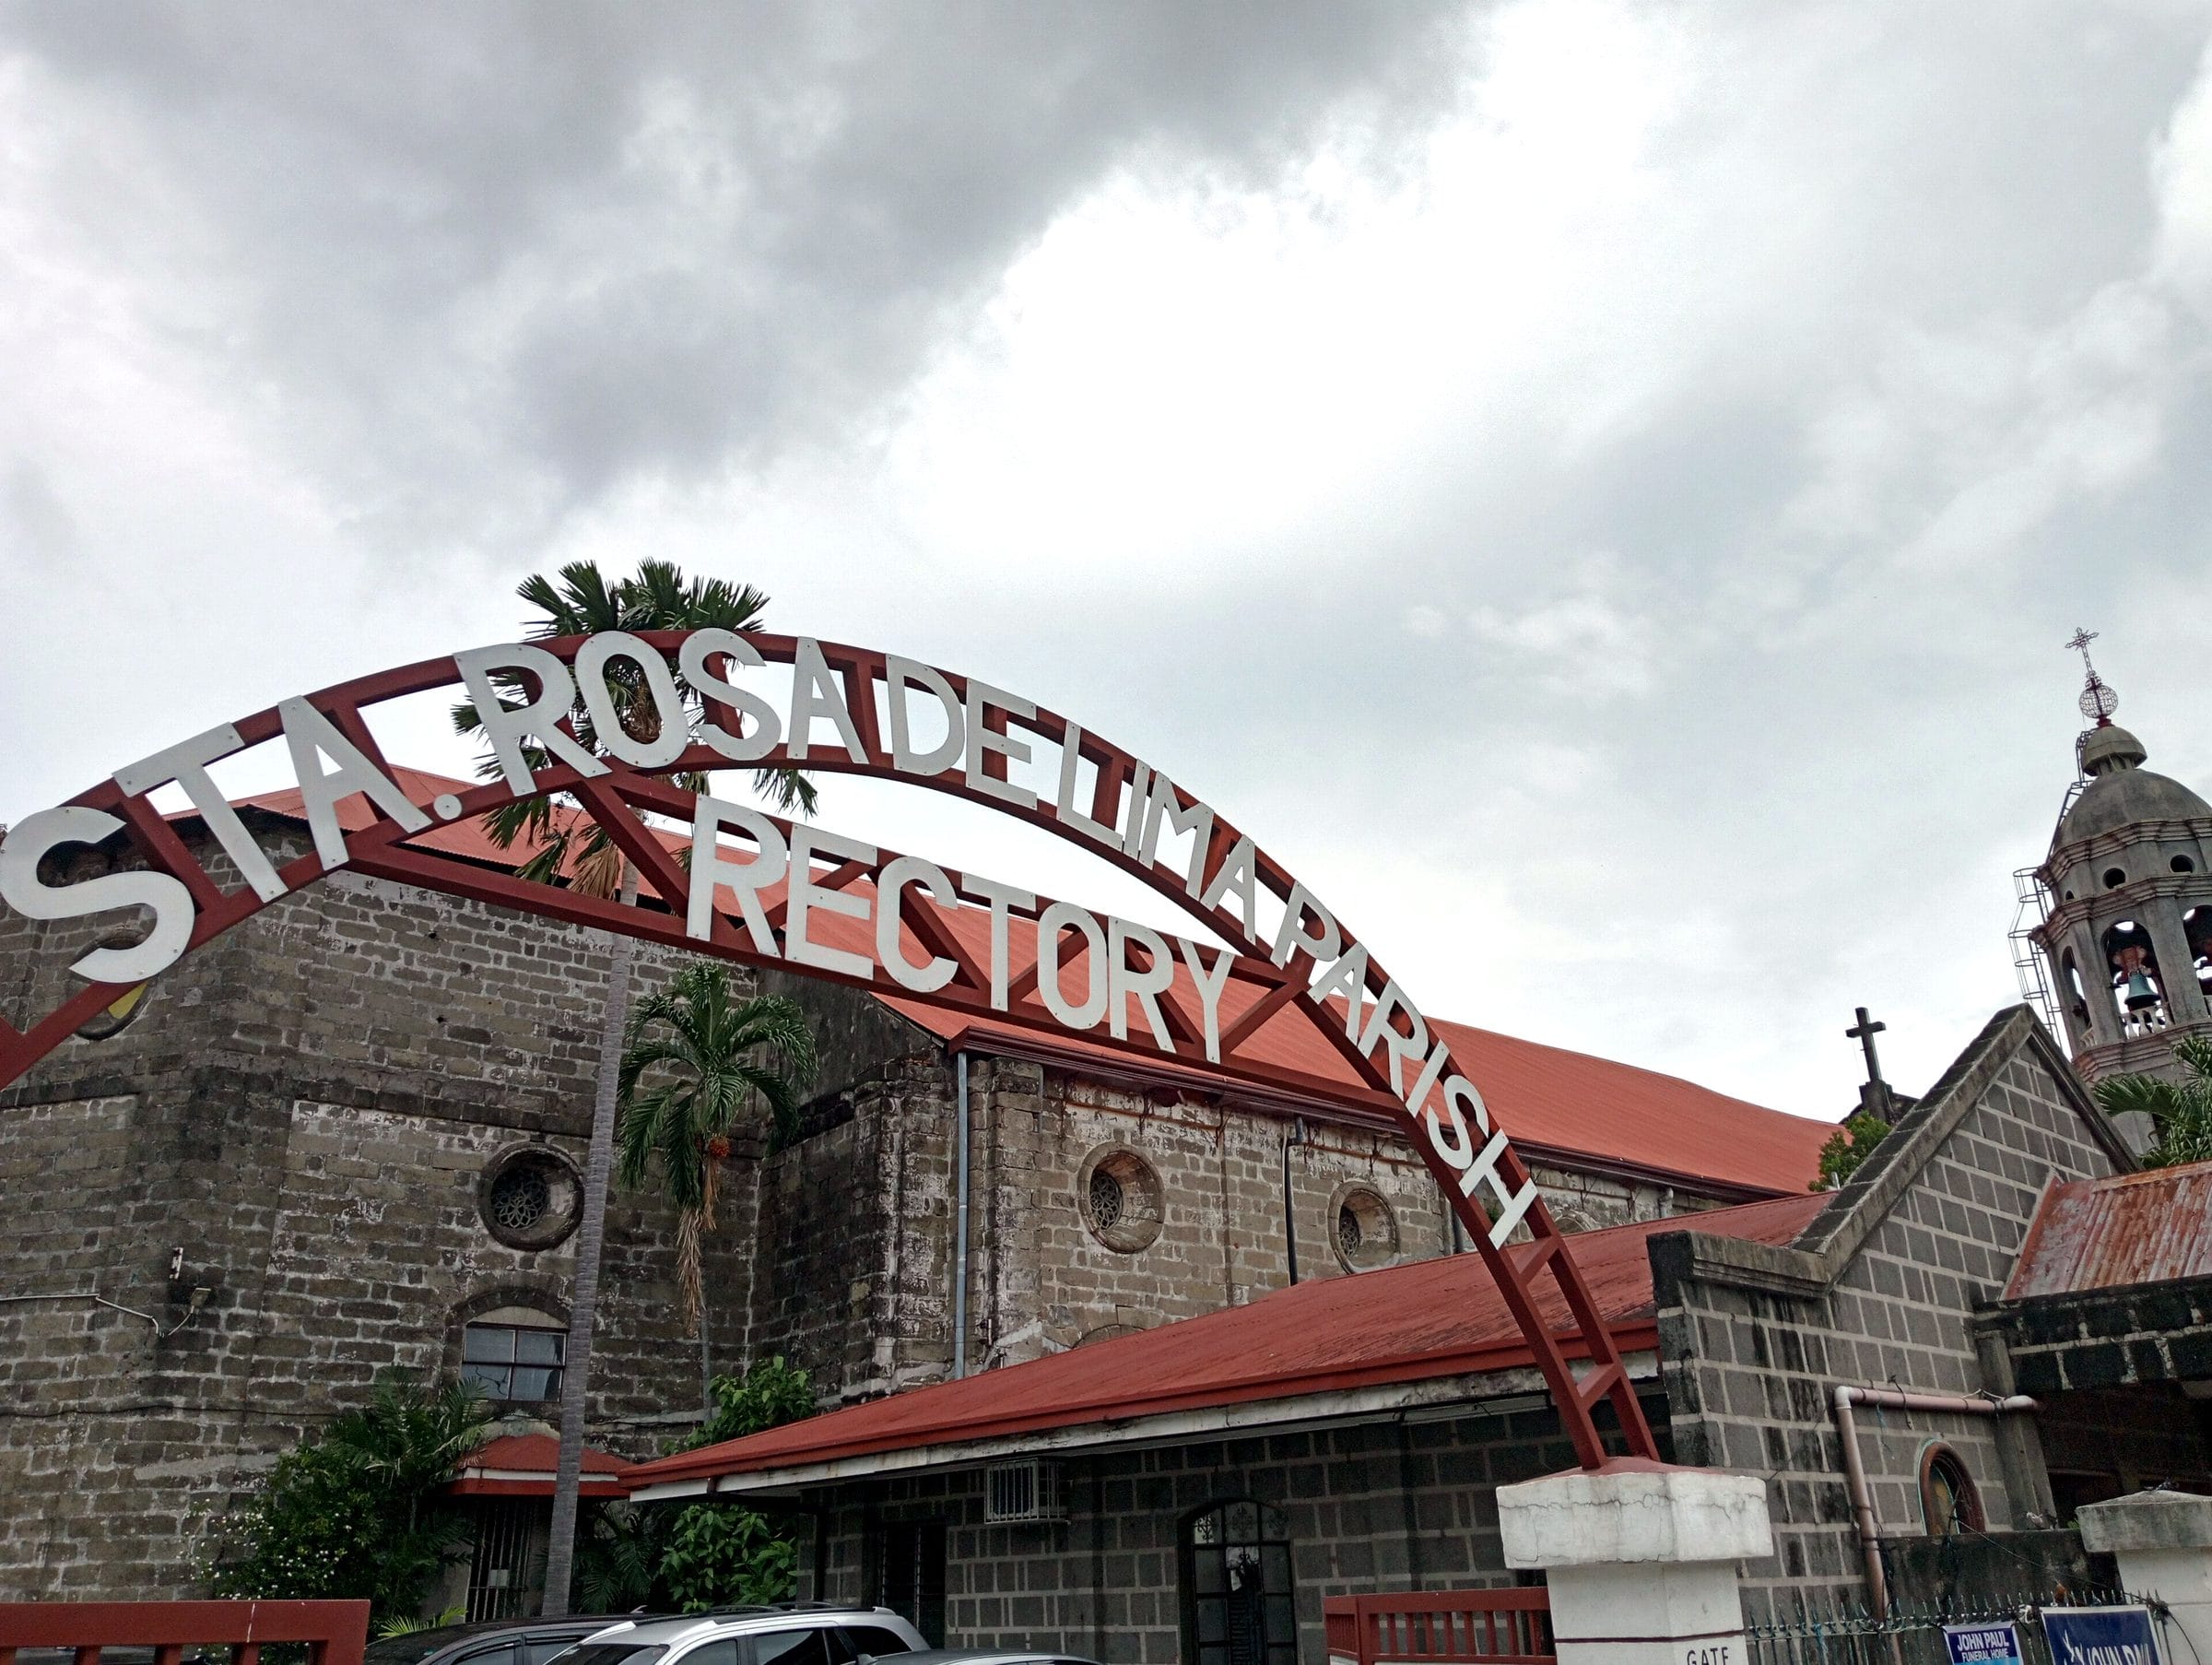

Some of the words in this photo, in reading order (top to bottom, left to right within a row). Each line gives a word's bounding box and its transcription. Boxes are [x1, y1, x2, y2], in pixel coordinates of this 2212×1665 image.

[0, 695, 463, 984] STA.
[453, 628, 869, 797] ROSA
[885, 653, 1038, 810] DE
[1055, 719, 1256, 945] LIMA
[1269, 880, 1539, 1251] PARISH
[686, 793, 1236, 1065] RECTORY
[1957, 1632, 1983, 1651] JOHN
[1983, 1630, 2010, 1648] PAUL
[1961, 1649, 1991, 1662] FUNERAL
[1991, 1647, 2009, 1659] HOME
